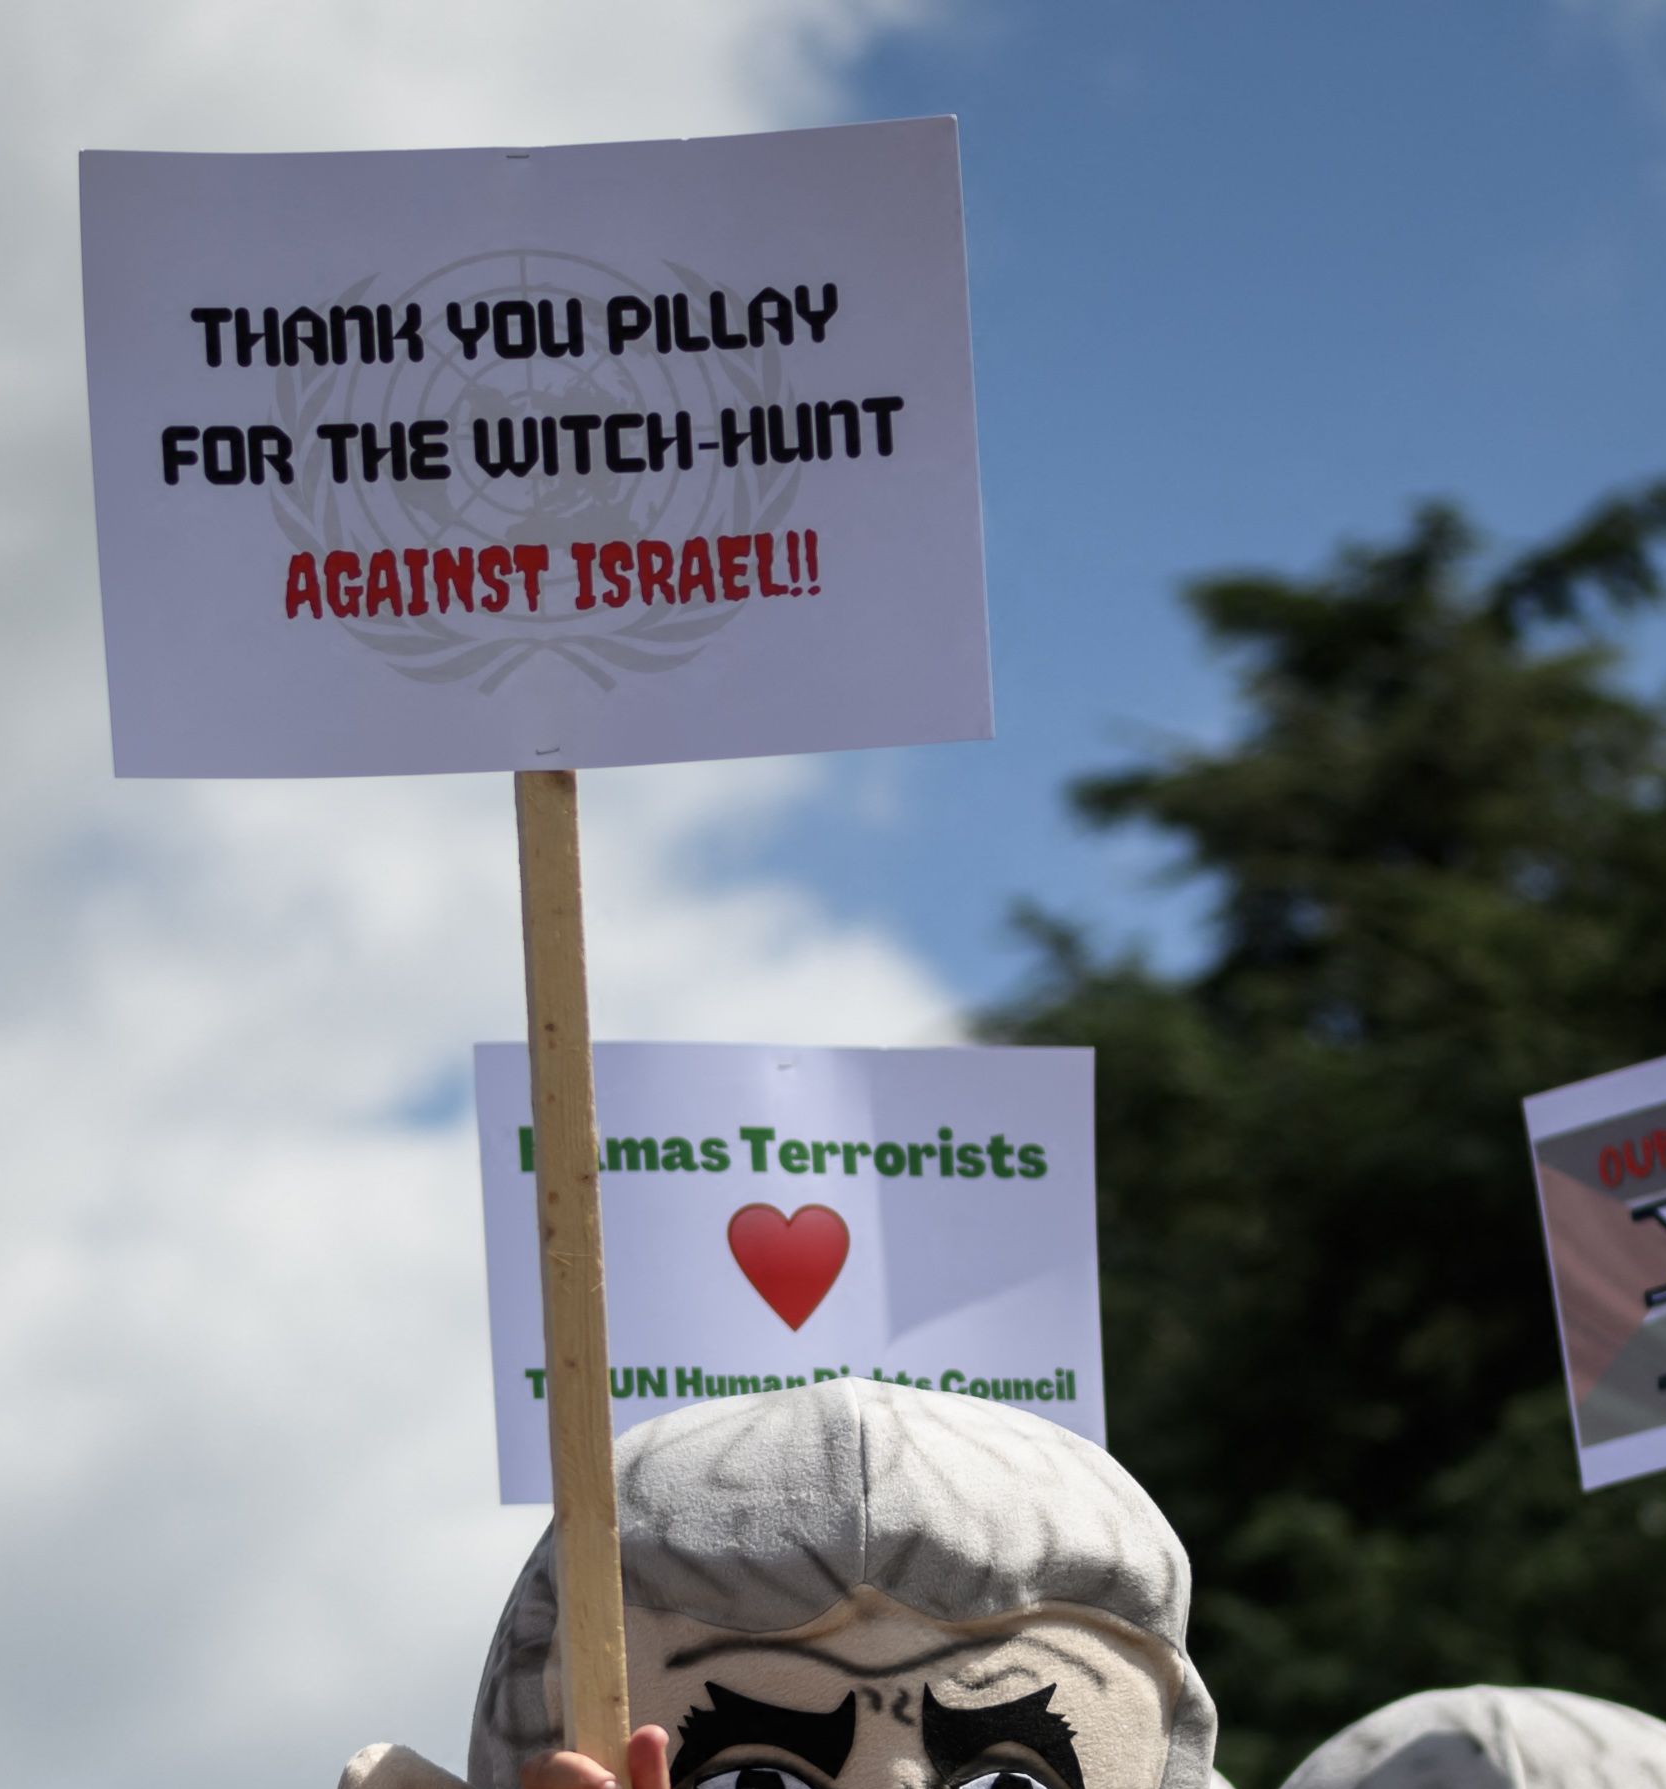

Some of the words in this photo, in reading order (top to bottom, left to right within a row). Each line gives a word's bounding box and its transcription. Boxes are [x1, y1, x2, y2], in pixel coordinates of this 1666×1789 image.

[189, 301, 425, 369] THANK
[444, 296, 586, 362] YOU
[605, 281, 840, 357] PILLAY
[160, 423, 296, 487] FOR
[315, 418, 453, 485] THE
[471, 394, 906, 480] WITCH-HUNT
[285, 542, 550, 619] AGAINST
[570, 530, 820, 611] ISRAEL!!
[518, 1126, 732, 1173] mas
[739, 1126, 1048, 1180] Terrorists
[609, 1366, 668, 1399] UN
[939, 1356, 1076, 1401] Council
